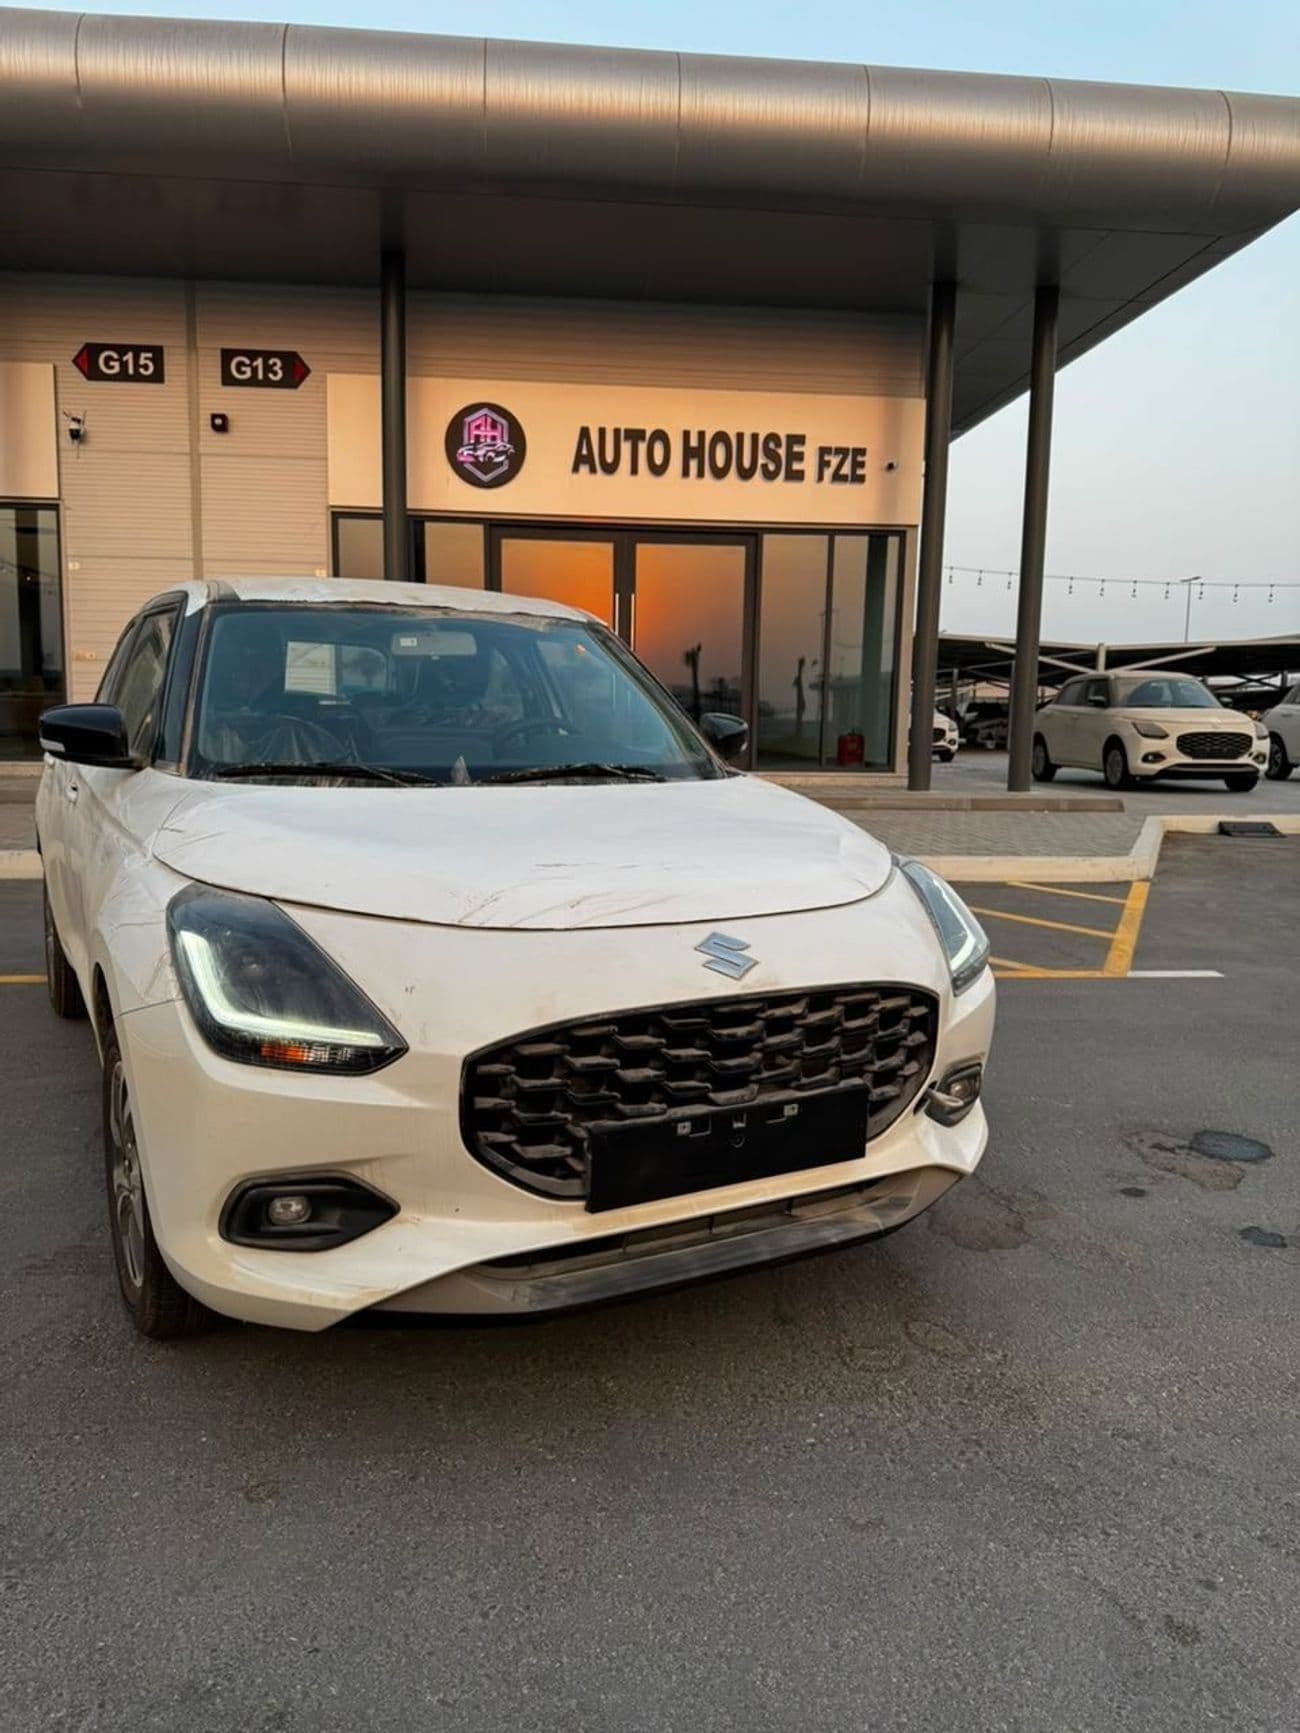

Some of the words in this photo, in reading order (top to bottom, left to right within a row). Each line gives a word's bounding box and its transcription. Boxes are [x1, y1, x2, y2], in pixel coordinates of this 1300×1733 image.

[99, 350, 155, 376] G15
[229, 356, 283, 381] G13
[572, 426, 671, 477] AUTO
[681, 430, 806, 481] HOUSE
[817, 446, 867, 483] FZE
